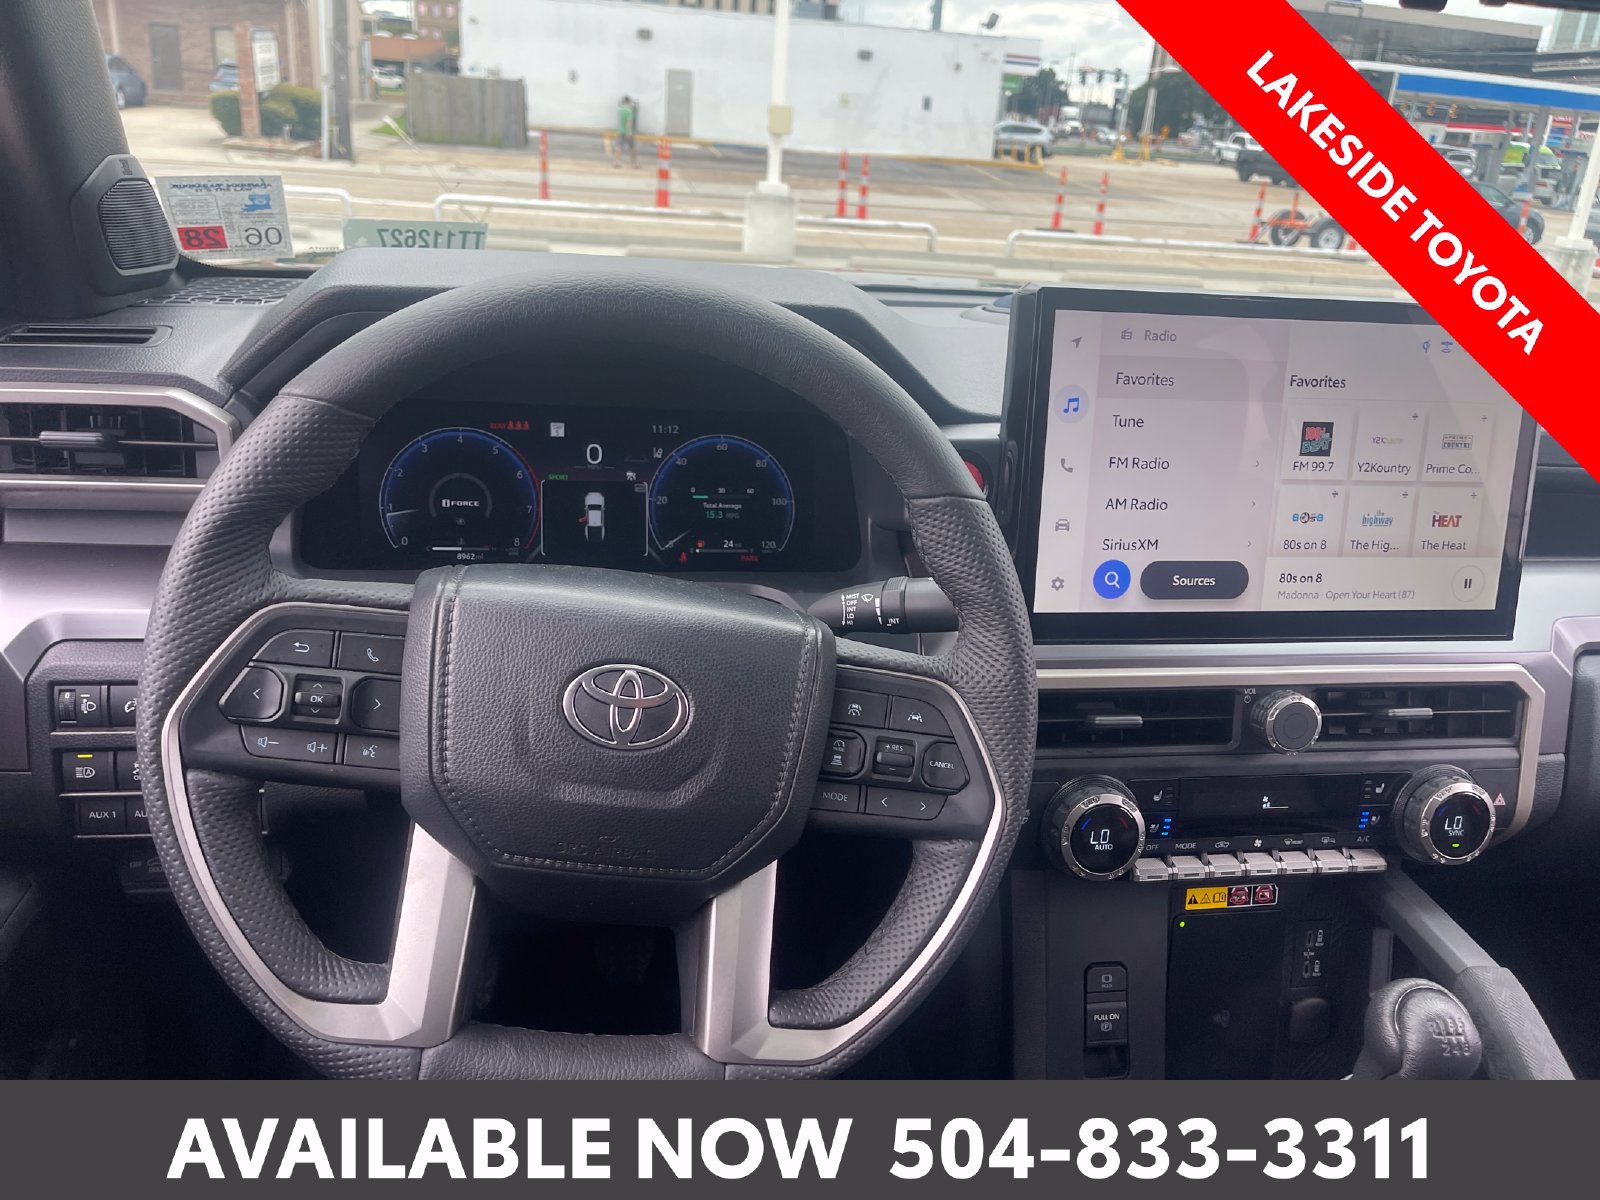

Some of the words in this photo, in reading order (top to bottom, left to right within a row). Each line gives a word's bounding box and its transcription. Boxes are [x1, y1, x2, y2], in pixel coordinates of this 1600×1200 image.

[1144, 330, 1177, 342] Radio
[1115, 372, 1175, 387] Favorites
[1289, 375, 1347, 389] Favorites
[1112, 414, 1145, 428] Tune
[652, 425, 680, 434] 11:12
[457, 435, 463, 443] 4
[422, 444, 428, 453] 3
[492, 446, 499, 455] 5
[716, 443, 728, 451] 60
[586, 443, 603, 465] 0
[675, 458, 687, 466] 40
[755, 460, 767, 468] 80
[1108, 456, 1129, 469] FM
[1132, 457, 1170, 470] Radio
[1292, 462, 1309, 472] FM
[1311, 462, 1334, 473] 99.7
[1357, 463, 1412, 475] Y2Kountry
[1426, 464, 1456, 474] Prime
[397, 470, 404, 478] 2
[516, 470, 523, 479] 6
[656, 496, 668, 504] 20
[772, 498, 787, 506] 100
[1105, 498, 1127, 511] AM
[1130, 498, 1168, 511] Radio
[527, 505, 532, 514] 7
[705, 511, 723, 519] 15.3
[1362, 513, 1393, 526] highway
[1431, 515, 1463, 528] HEAT
[401, 536, 408, 546] 0
[513, 537, 520, 546] 8
[723, 540, 734, 548] 24
[761, 541, 777, 549] 120
[1102, 538, 1159, 551] SiriusXM
[1283, 540, 1301, 550] 80s
[1303, 542, 1316, 550] on
[1320, 540, 1327, 550] 8
[1350, 540, 1369, 550] The
[1421, 540, 1440, 550] The
[1442, 540, 1467, 550] Heat
[1172, 574, 1216, 587] Sources
[1279, 573, 1298, 584] 80s
[1299, 575, 1313, 584] on
[1315, 573, 1323, 584] 8
[1277, 590, 1319, 600] Madonna
[1325, 591, 1350, 601] Open
[1351, 591, 1372, 600] Your
[1373, 591, 1397, 600] Heart
[1398, 590, 1416, 601] (87)
[310, 695, 324, 703] OK
[929, 761, 955, 770] CANCEL
[822, 791, 849, 802] MODE
[88, 811, 110, 819] AUX
[112, 811, 117, 819] 1
[134, 811, 148, 819] AU
[1356, 835, 1371, 843] A/C
[1175, 842, 1197, 850] MODE
